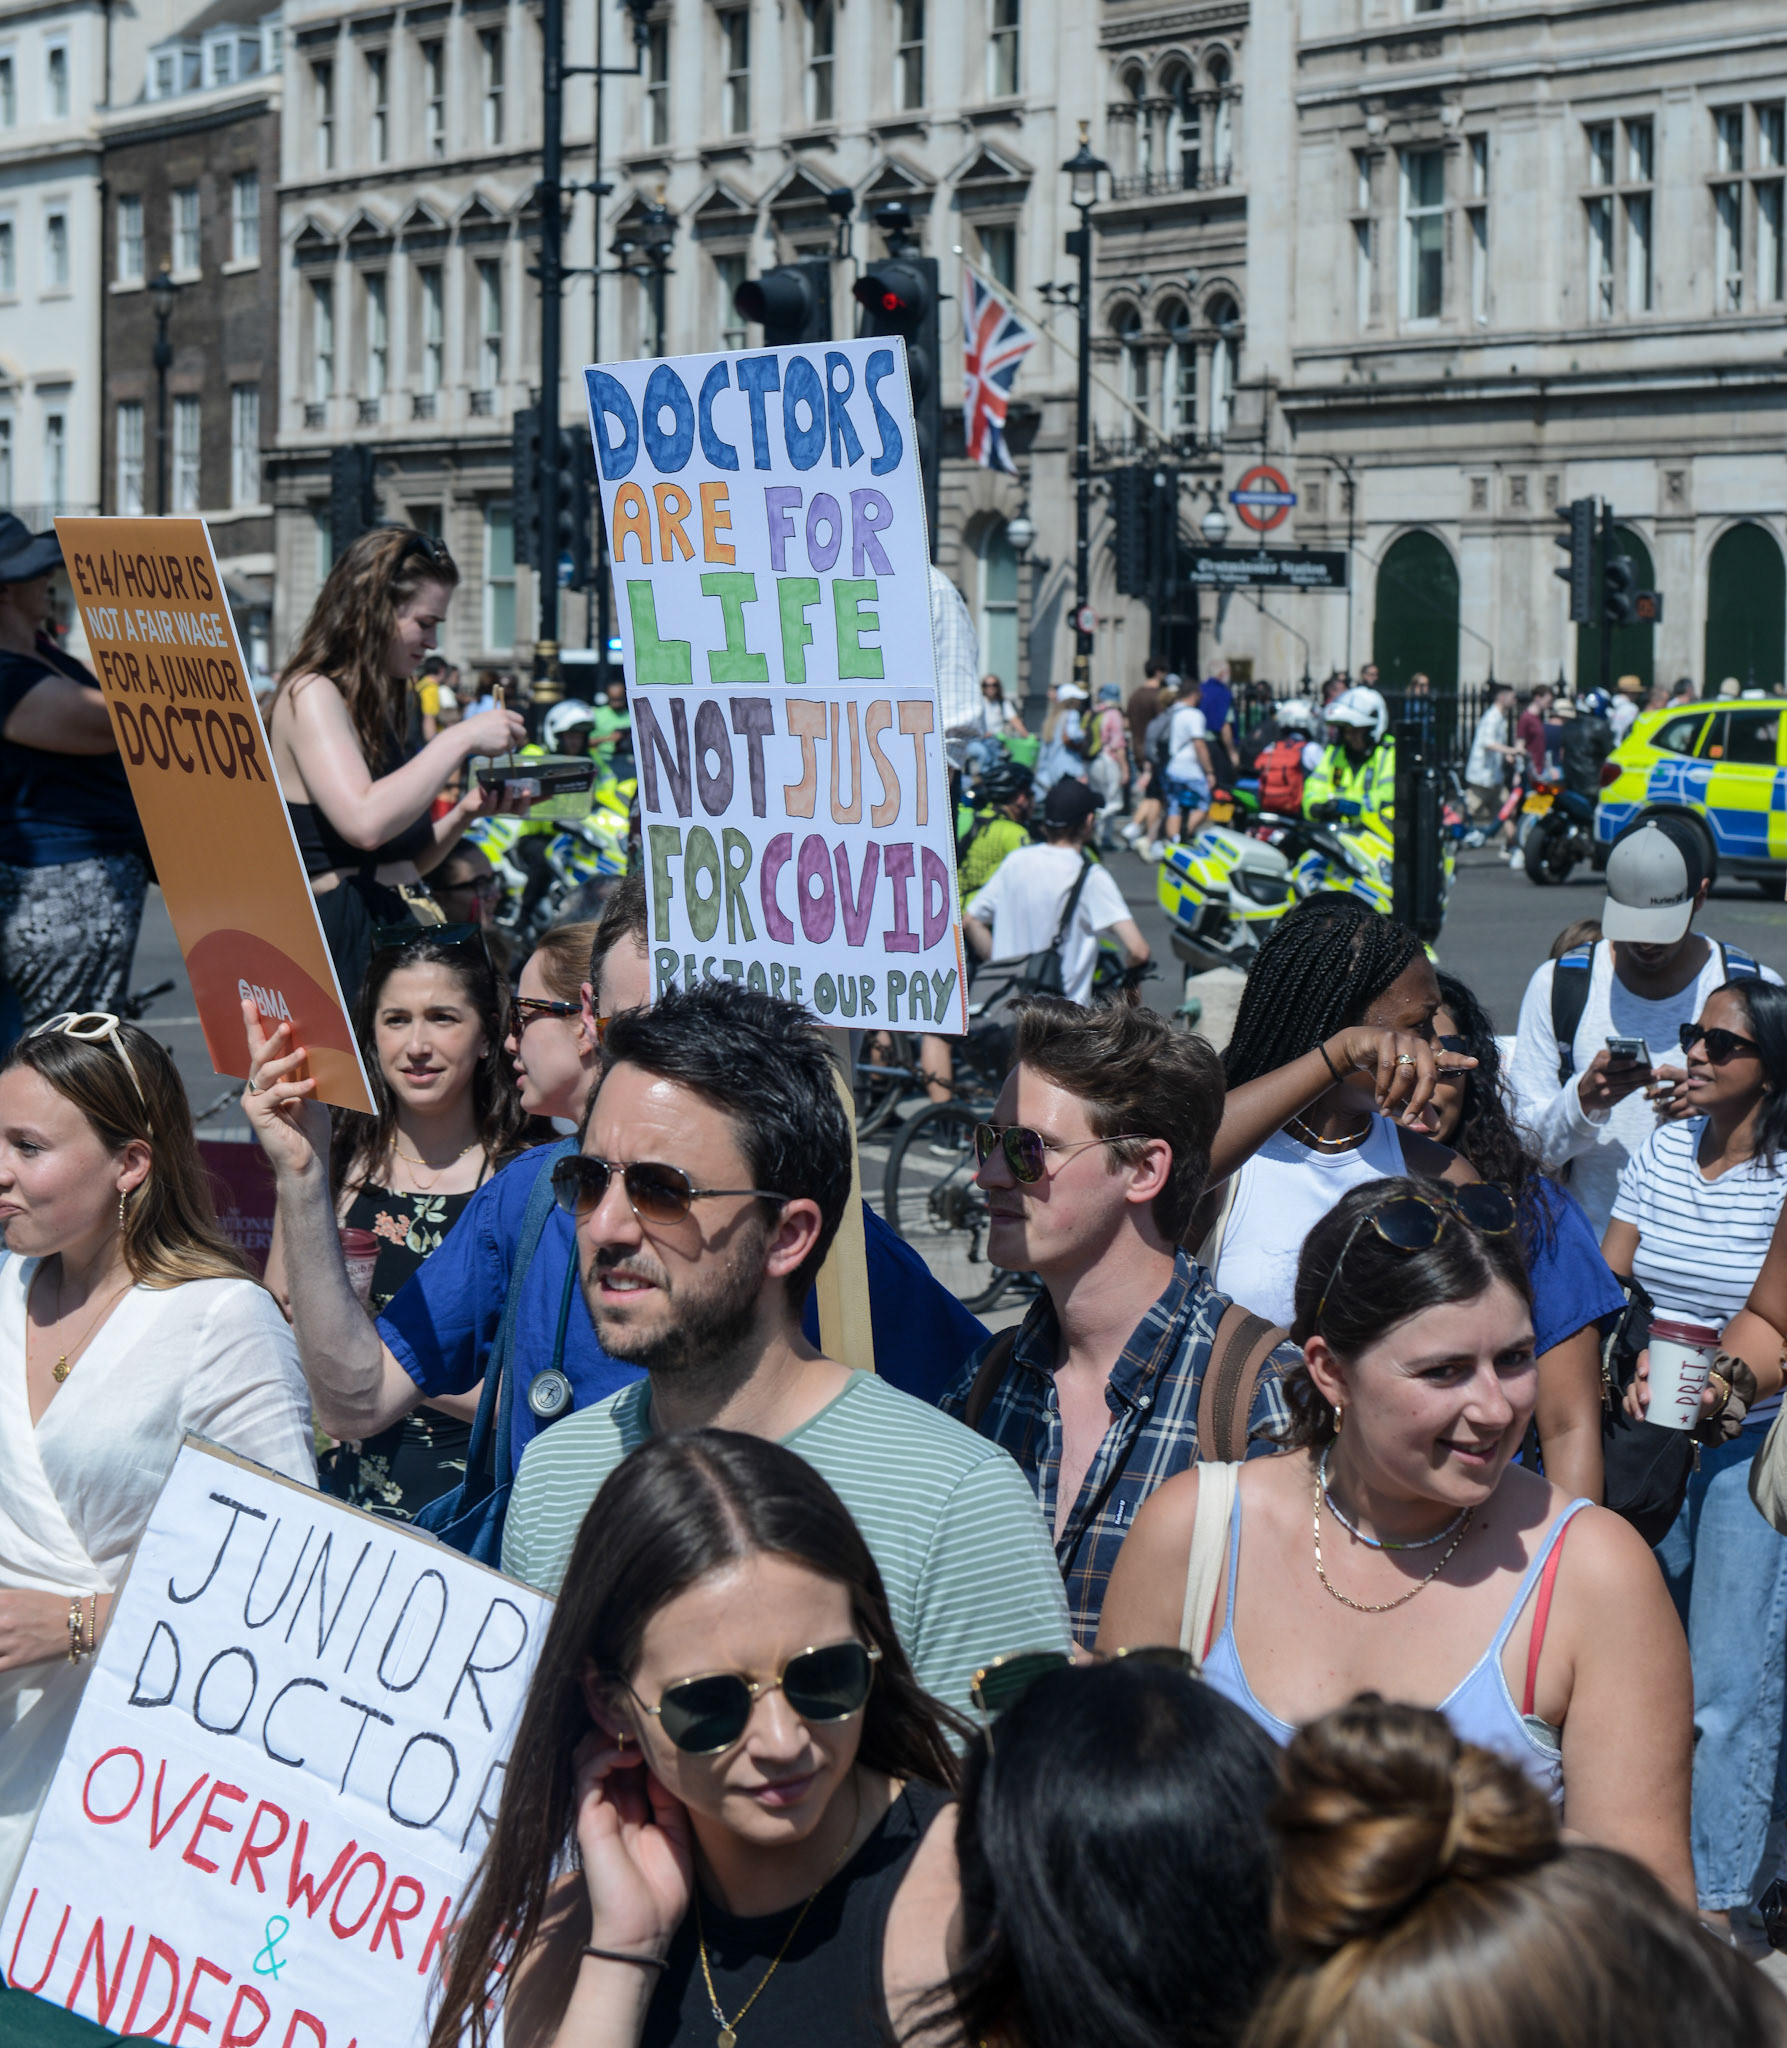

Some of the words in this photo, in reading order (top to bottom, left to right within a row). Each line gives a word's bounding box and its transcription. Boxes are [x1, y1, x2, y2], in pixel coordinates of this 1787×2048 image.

[585, 350, 903, 481] DOCTORS
[612, 481, 736, 566] ARE
[764, 486, 895, 576] FOR
[74, 550, 189, 600] £14/HOUR
[185, 555, 213, 601] IS
[85, 607, 122, 641] NOT
[125, 608, 140, 642] A
[138, 609, 178, 644] FAIR
[172, 611, 228, 648] WAGE
[626, 572, 885, 685] LIFE
[98, 650, 147, 694] FOR
[148, 654, 165, 695] A
[160, 654, 244, 703] JUNIOR
[113, 700, 267, 782] DOCTOR
[632, 697, 775, 818] NOT
[783, 698, 934, 828] JUST
[648, 824, 756, 944] FOR
[760, 832, 950, 954] COVID
[252, 984, 293, 1023] BMA
[814, 972, 877, 1018] OUR
[887, 968, 958, 1025] PAY
[1675, 1360, 1707, 1406] PRET
[168, 1492, 529, 1732] JUNIOR
[82, 1746, 519, 2008] OVERWORK
[253, 1915, 290, 1981] &
